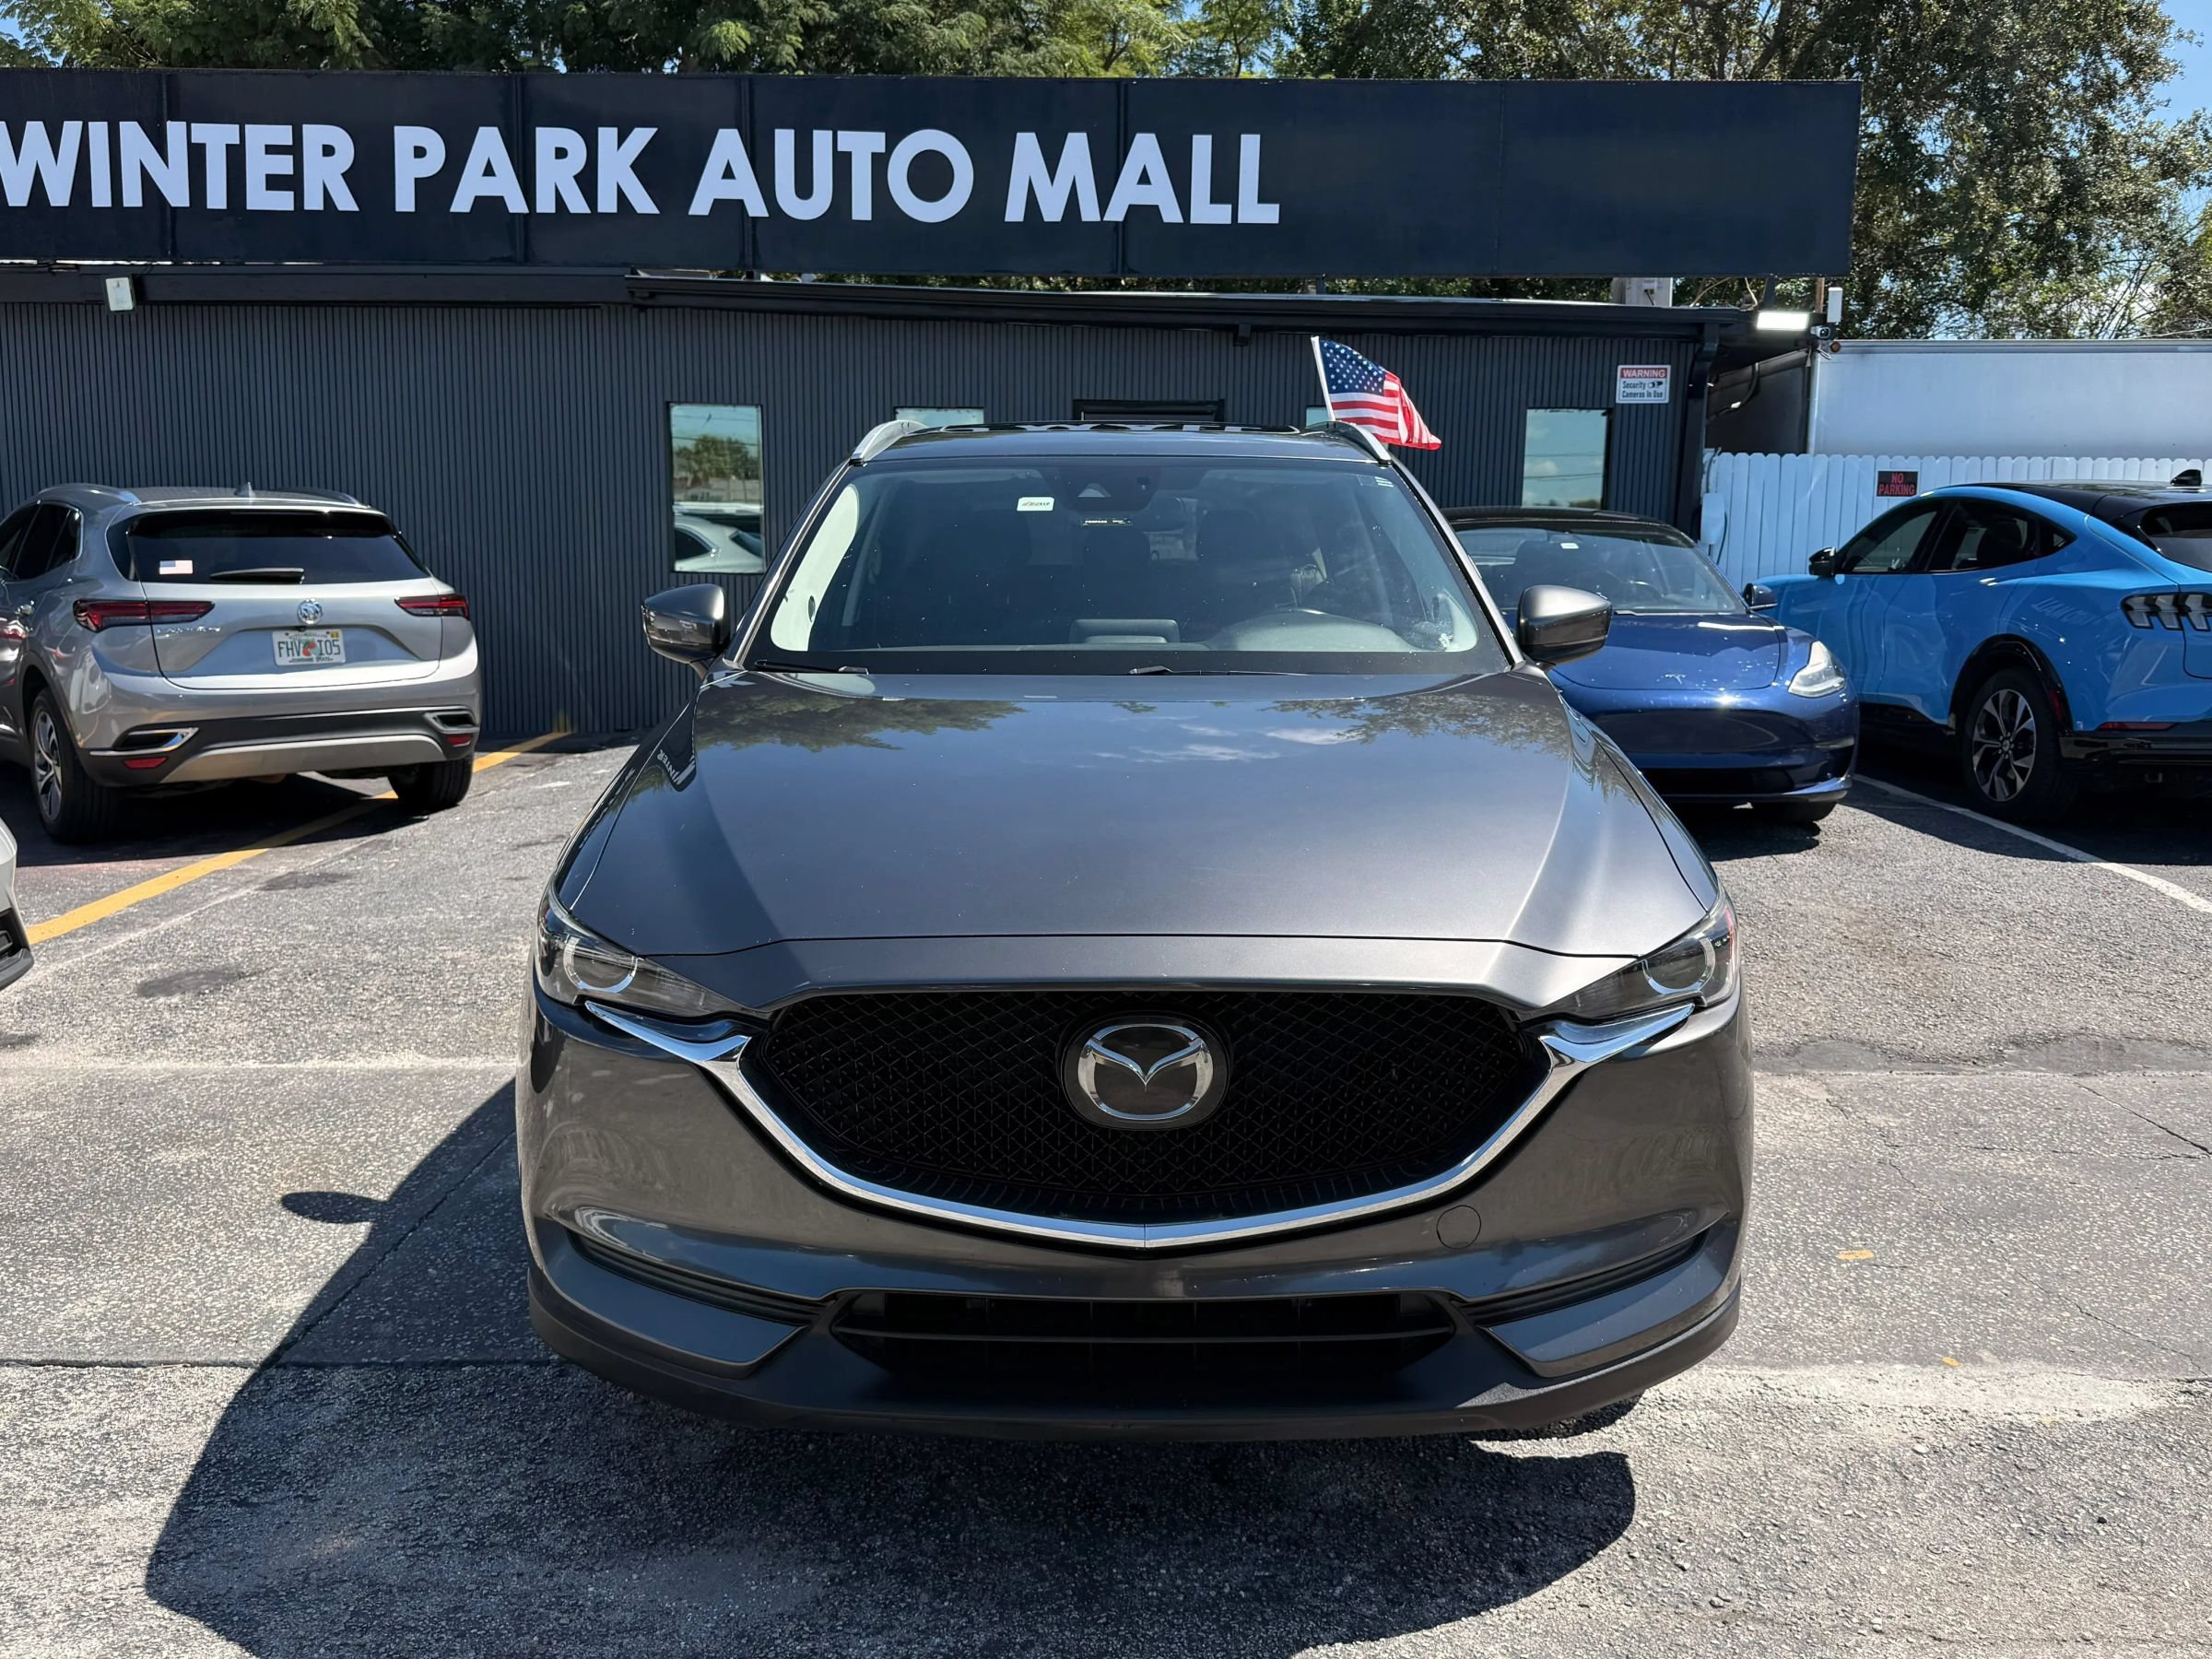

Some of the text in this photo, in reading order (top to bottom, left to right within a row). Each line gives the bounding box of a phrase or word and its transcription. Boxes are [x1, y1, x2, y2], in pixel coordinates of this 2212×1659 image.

[0, 120, 1280, 224] WINTER PARK AUTO MALL
[1622, 369, 1666, 378] WARNING
[1622, 381, 1646, 390] Security
[1891, 472, 1904, 484] NO
[1878, 483, 1915, 496] PARKING
[277, 641, 301, 658] FHV
